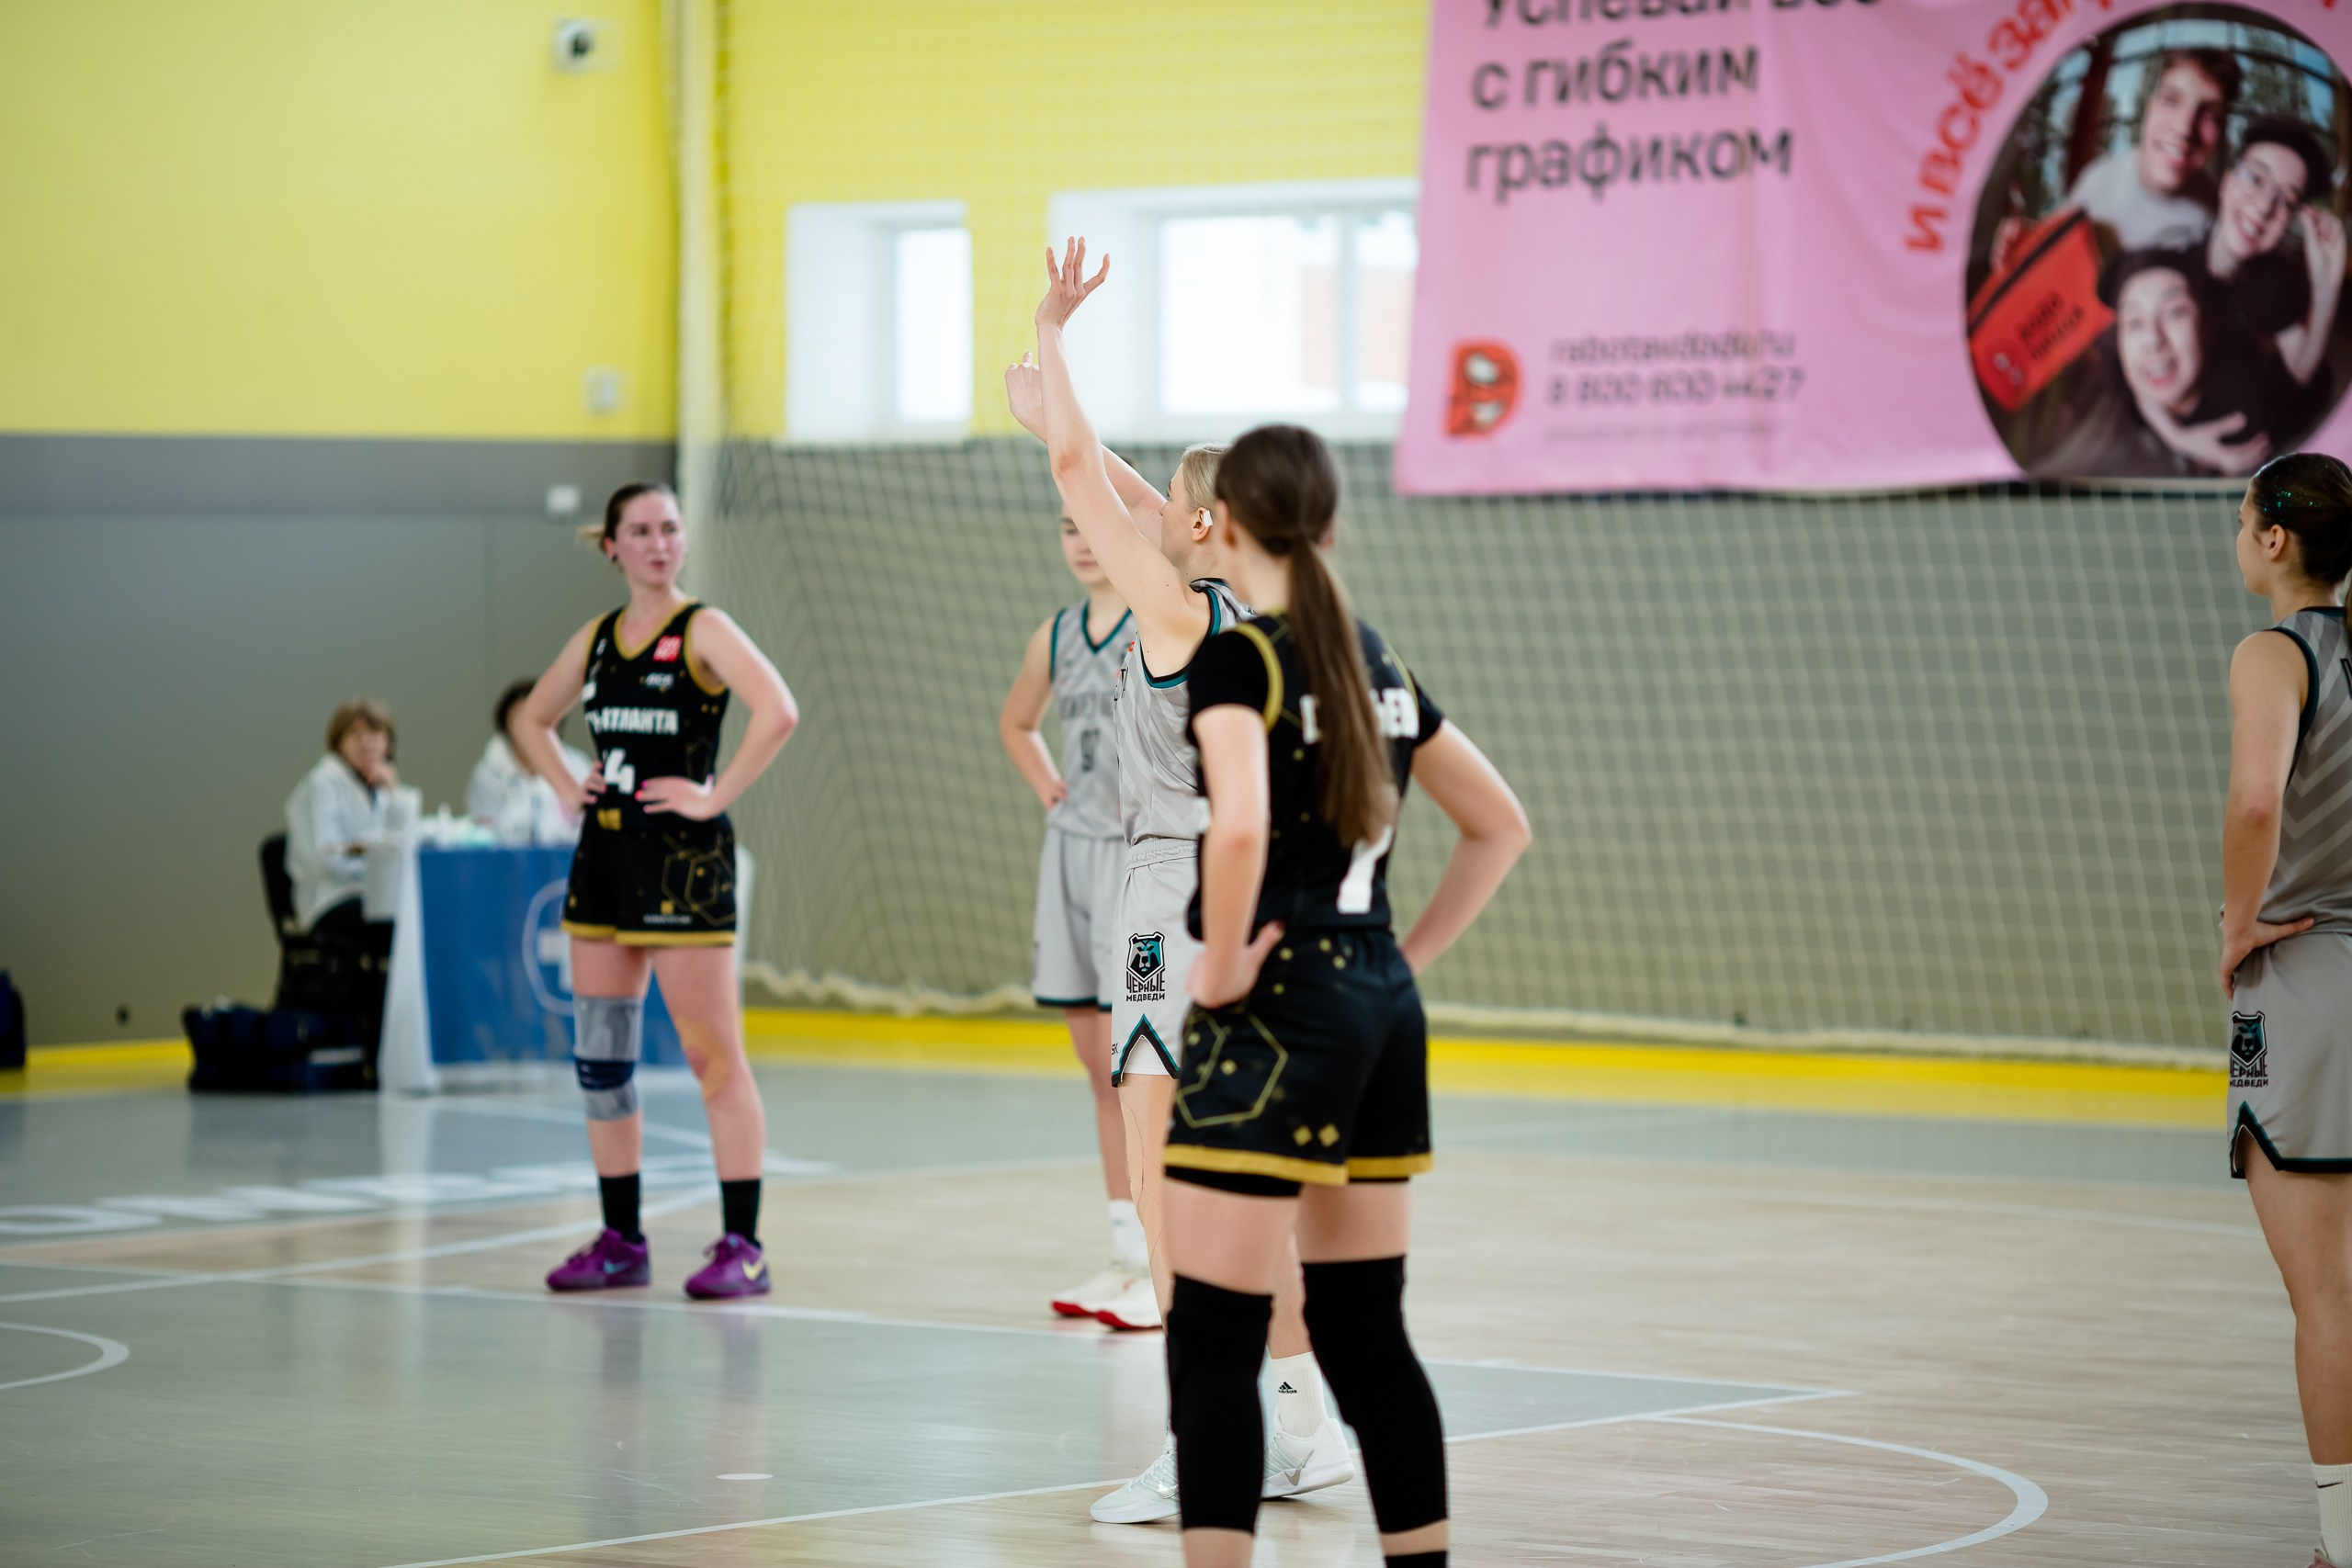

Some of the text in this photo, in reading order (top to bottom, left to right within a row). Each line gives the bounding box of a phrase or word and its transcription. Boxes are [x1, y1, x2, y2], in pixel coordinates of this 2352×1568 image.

[1473, 39, 1760, 109] с гибким
[1919, 51, 2005, 198] всё
[1467, 122, 1794, 206] графиком
[1125, 992, 1166, 1003] МЕДВЕДИ
